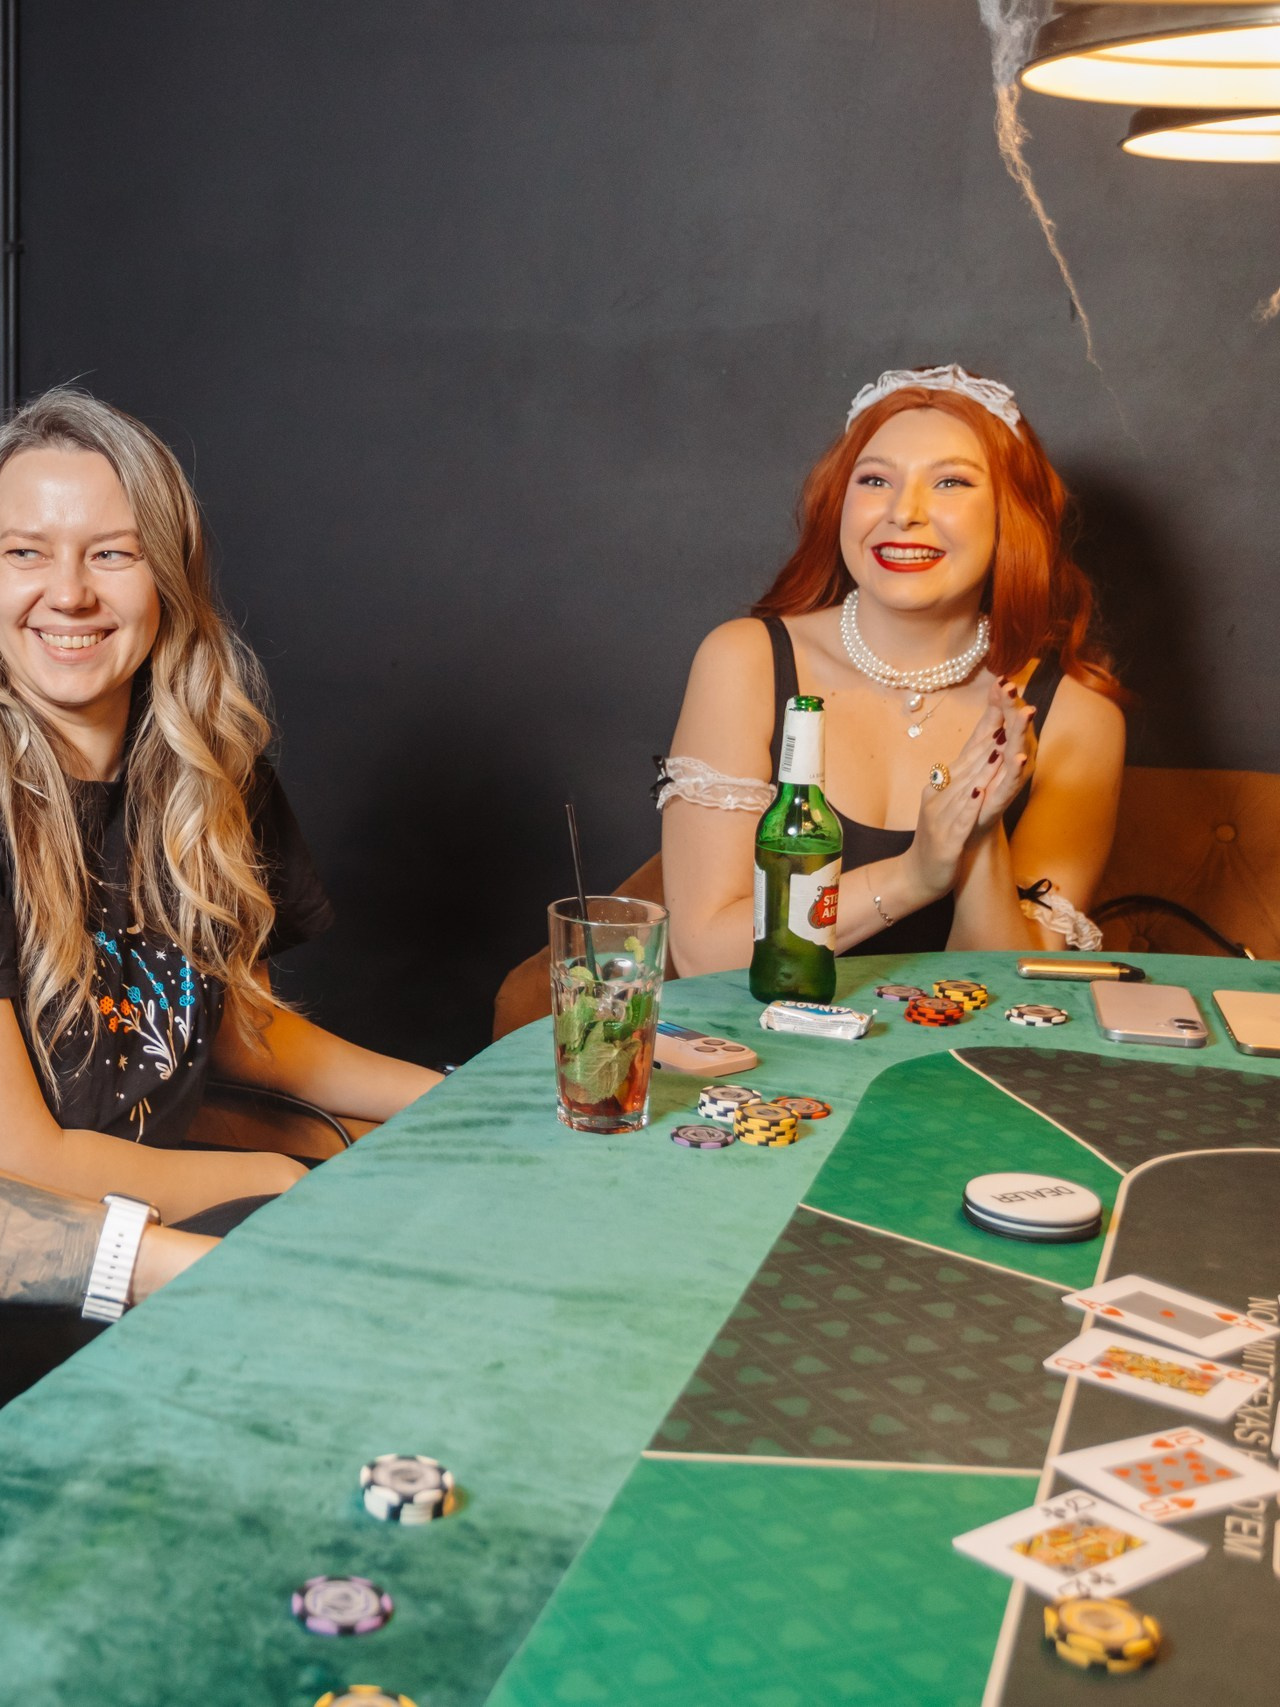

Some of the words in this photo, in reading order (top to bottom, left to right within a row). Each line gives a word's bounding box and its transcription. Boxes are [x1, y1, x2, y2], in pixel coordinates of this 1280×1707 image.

[823, 894, 839, 906] STE
[822, 907, 837, 919] AR
[782, 1001, 851, 1014] BOUNTY
[991, 1186, 1075, 1204] DEALER
[1247, 1297, 1278, 1322] NO
